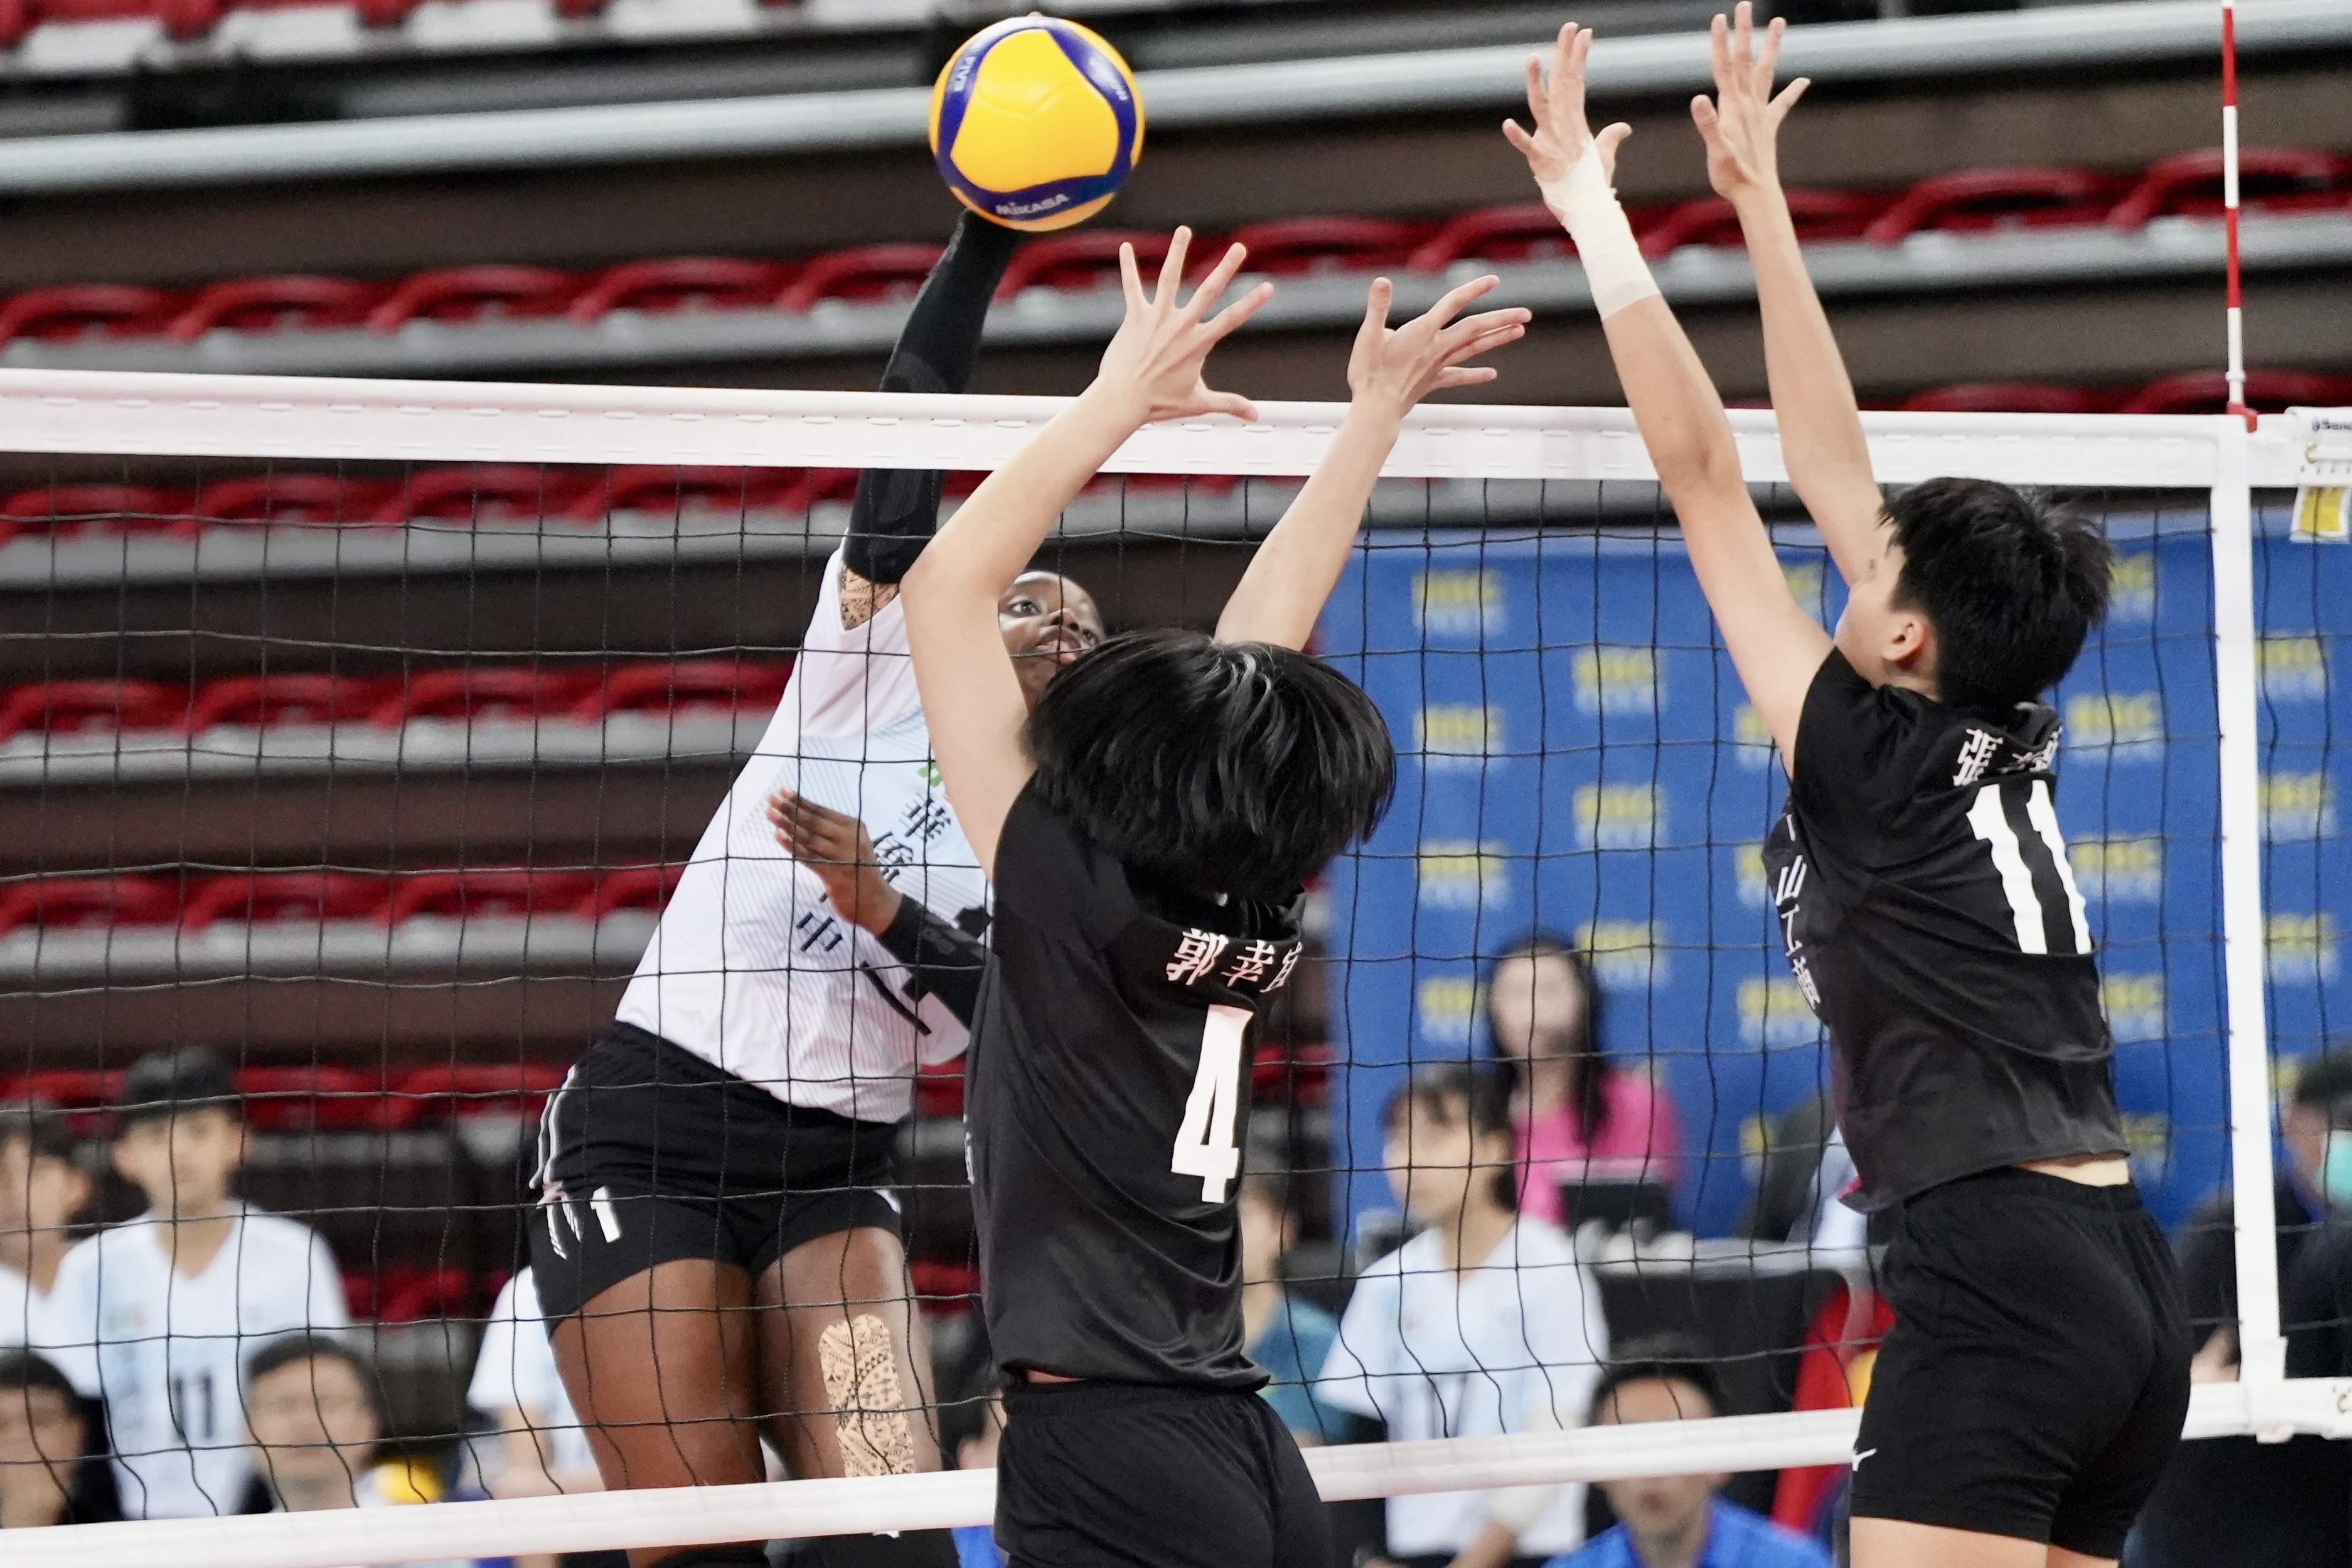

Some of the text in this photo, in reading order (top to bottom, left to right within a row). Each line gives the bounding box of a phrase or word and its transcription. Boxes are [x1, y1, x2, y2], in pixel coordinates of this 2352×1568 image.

[995, 193, 1070, 216] MIKASA
[1966, 779, 2092, 955] 11
[1171, 1004, 1254, 1204] 4
